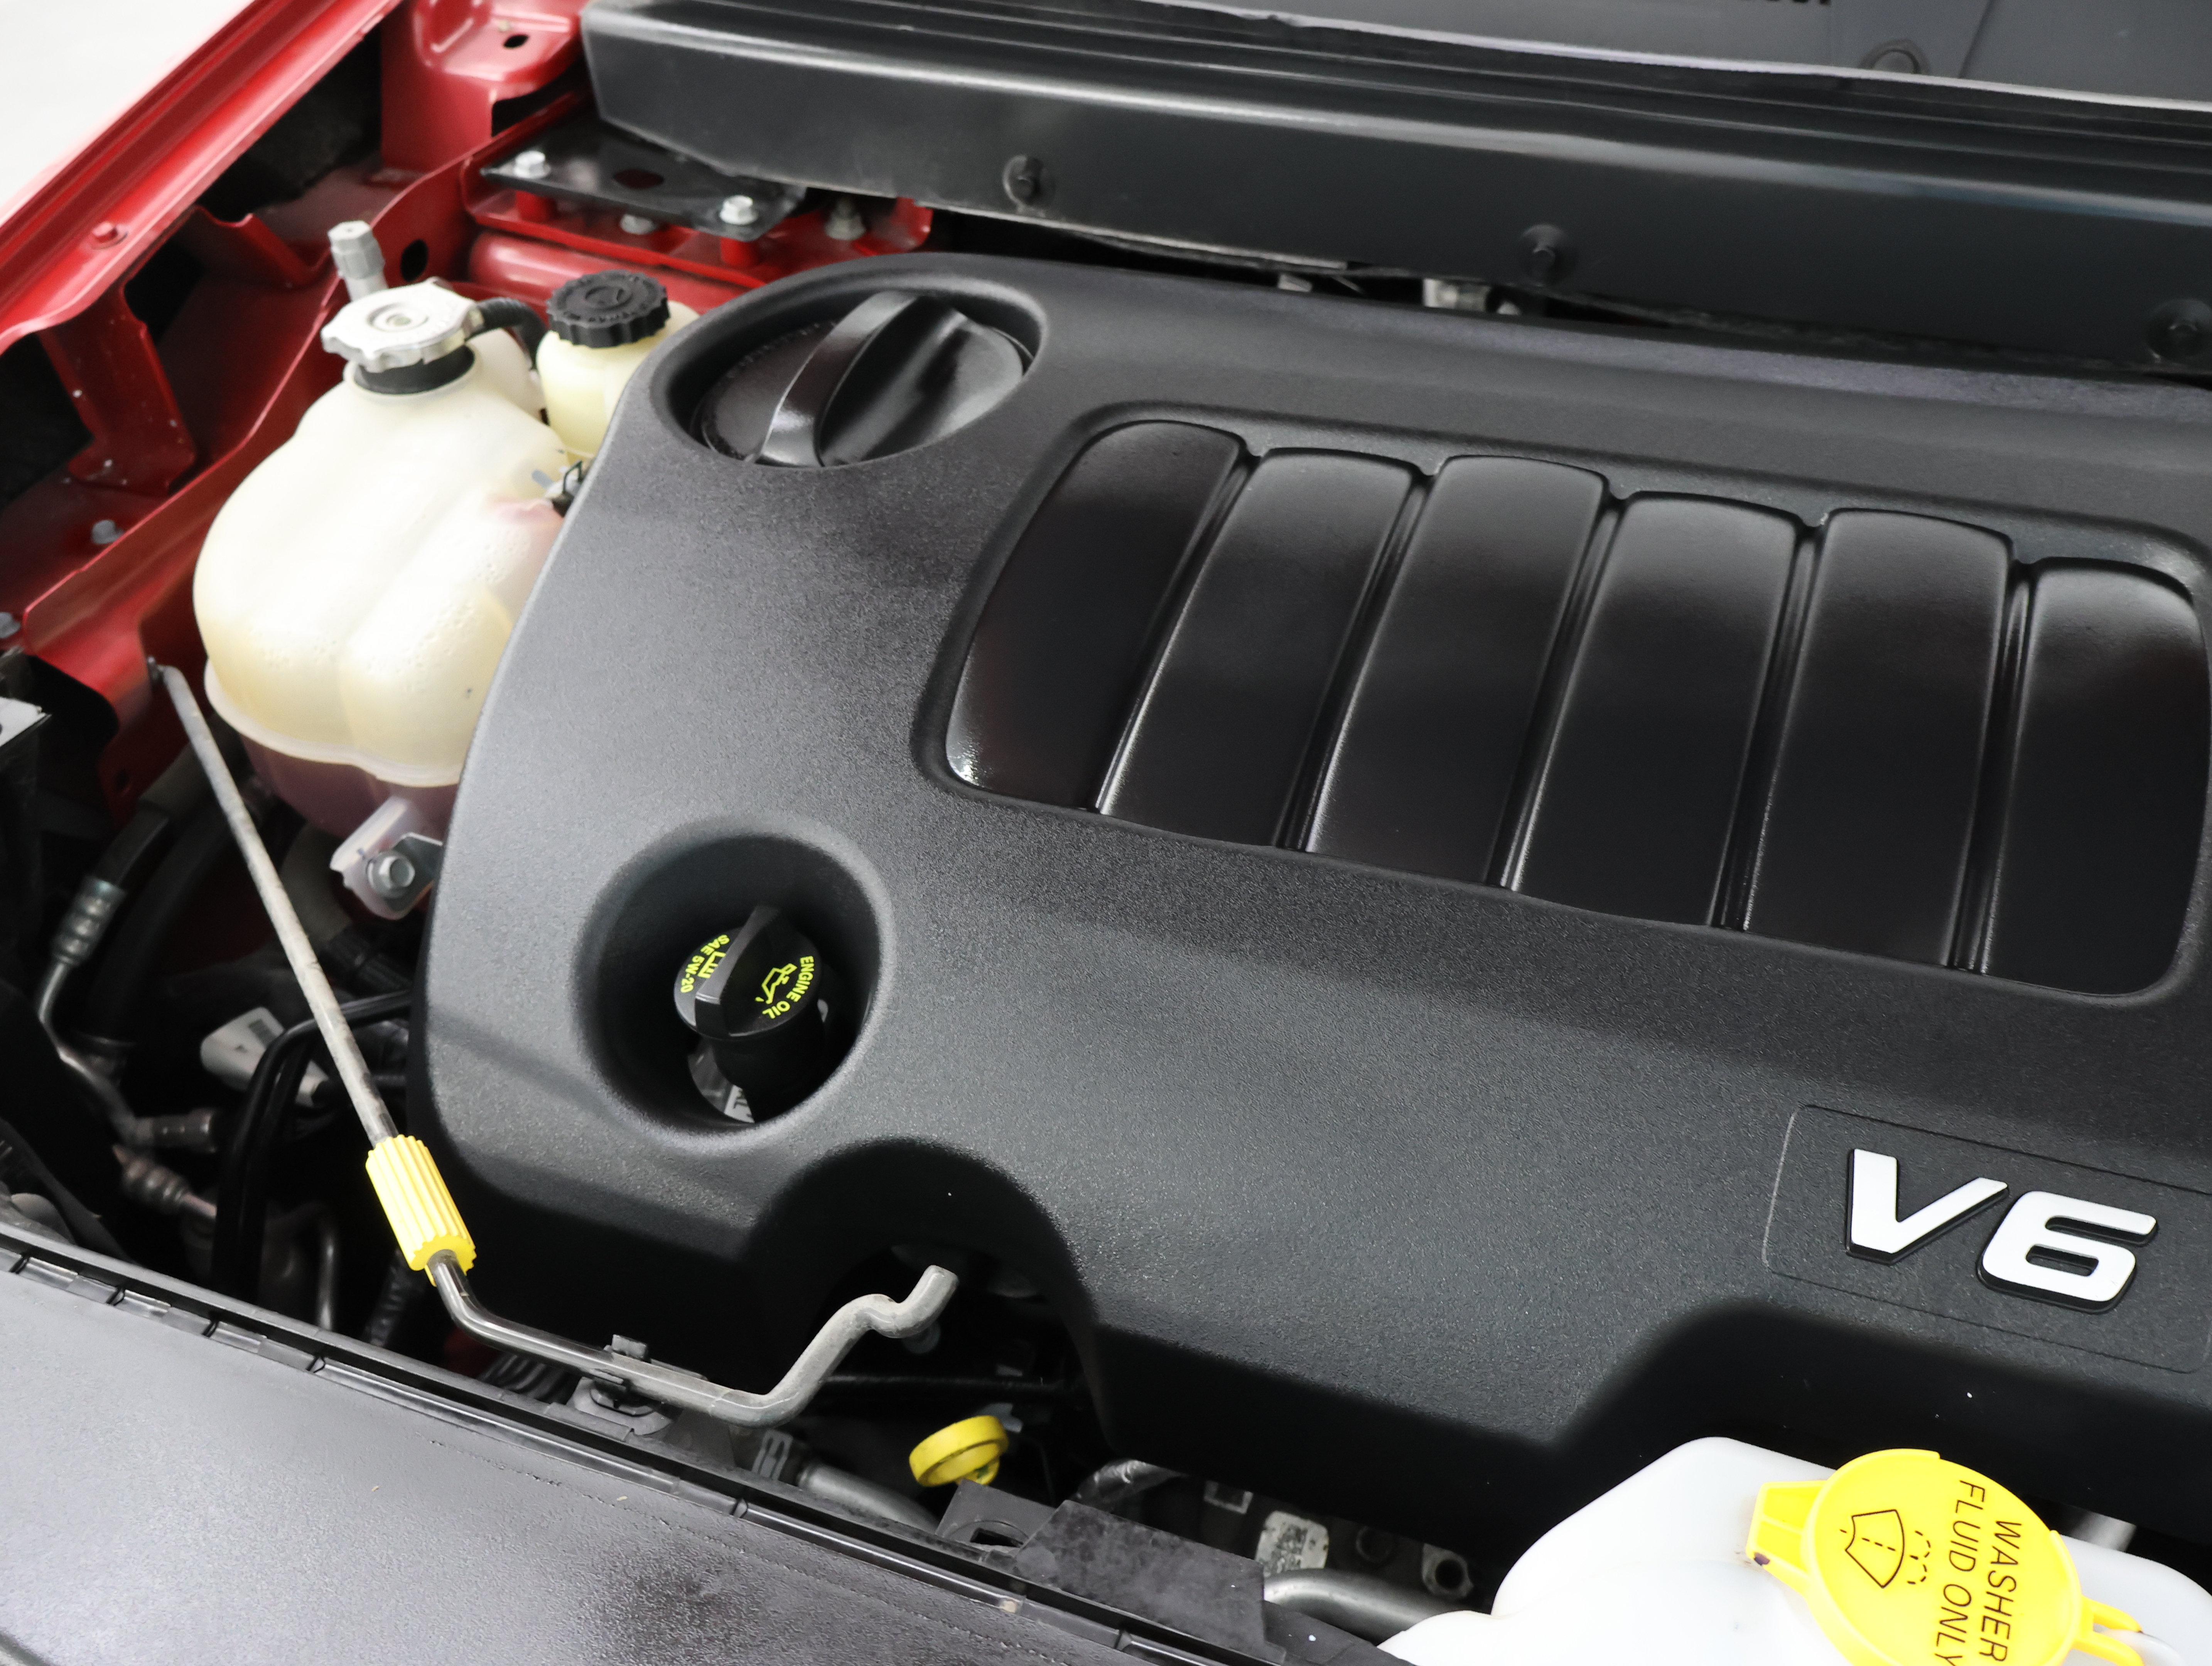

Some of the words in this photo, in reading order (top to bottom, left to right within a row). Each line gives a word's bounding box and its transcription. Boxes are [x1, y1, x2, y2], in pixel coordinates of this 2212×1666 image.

[680, 955, 705, 993] 5W-20
[700, 934, 730, 956] SAE
[762, 1000, 791, 1019] OIL
[786, 955, 815, 1003] ENGINE
[1850, 1147, 2158, 1305] V6
[1949, 1479, 1985, 1572] FLUID
[1979, 1521, 2022, 1662] WASHER
[1934, 1583, 1972, 1666] ONLY
